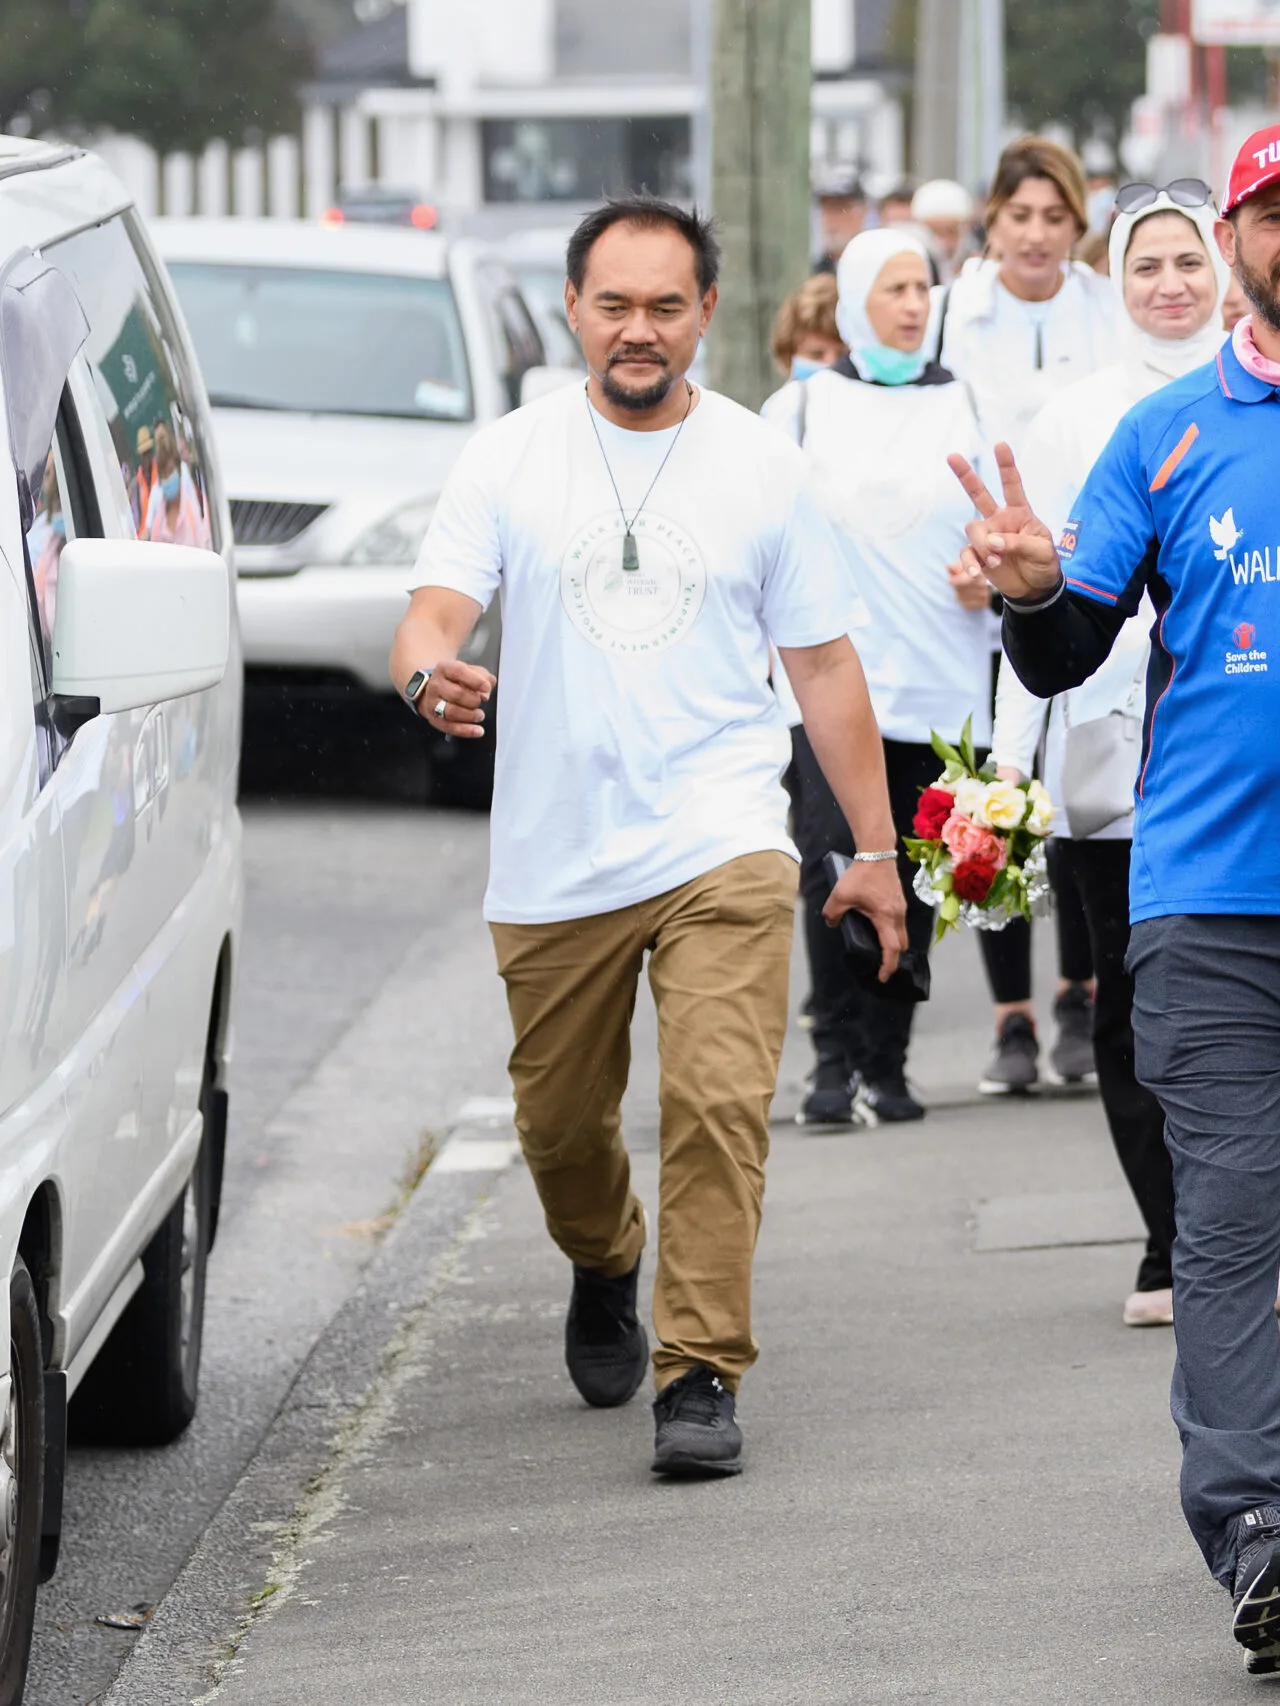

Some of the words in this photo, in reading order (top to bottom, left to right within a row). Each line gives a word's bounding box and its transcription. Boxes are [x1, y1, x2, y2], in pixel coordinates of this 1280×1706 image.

[656, 524, 697, 566] PEACE
[1225, 652, 1247, 662] Save
[1249, 650, 1267, 660] the
[1225, 663, 1268, 674] Children
